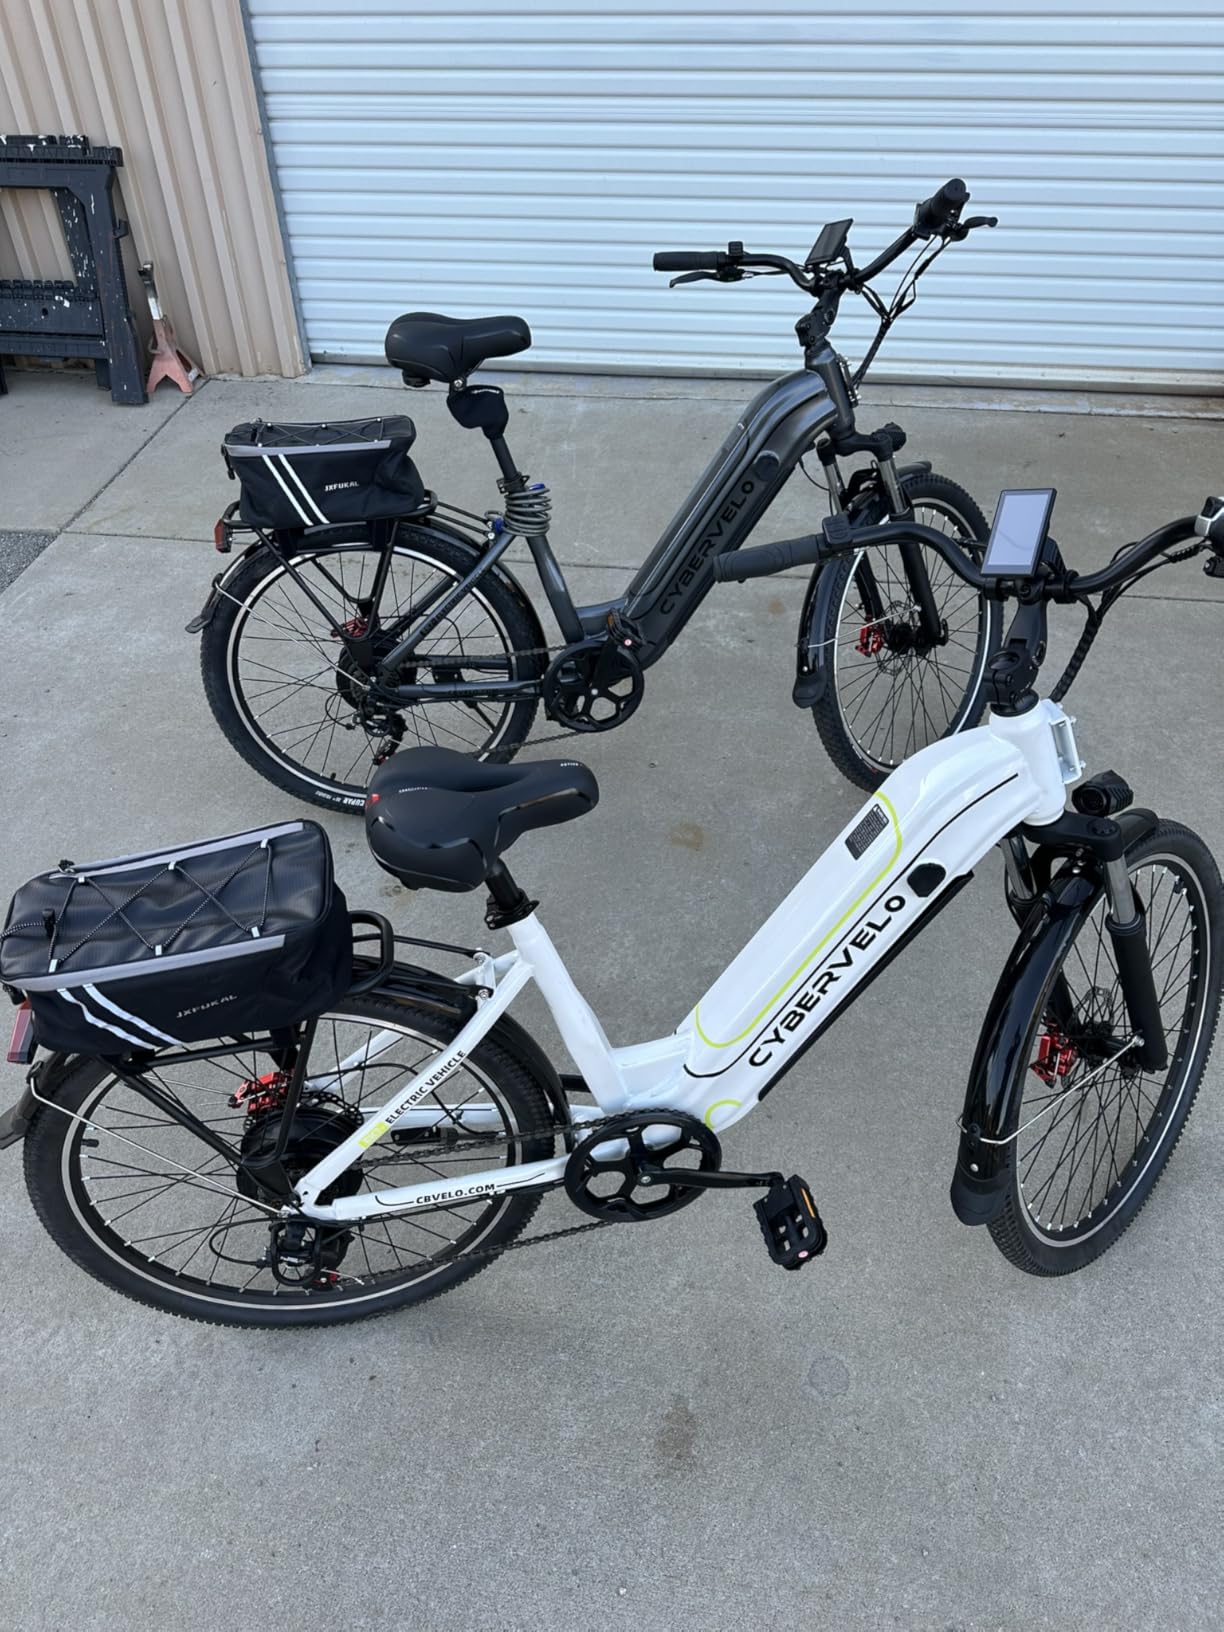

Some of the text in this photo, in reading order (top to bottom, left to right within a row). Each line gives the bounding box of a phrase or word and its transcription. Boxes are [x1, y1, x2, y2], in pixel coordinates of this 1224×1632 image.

[659, 480, 755, 615] CYBERVELO
[176, 994, 238, 1019] JXFUKAL
[748, 895, 906, 1067] CYBERVELO
[385, 1050, 466, 1125] ELECTRIC VEHICLE
[416, 1184, 496, 1204] CBVELO.COM
